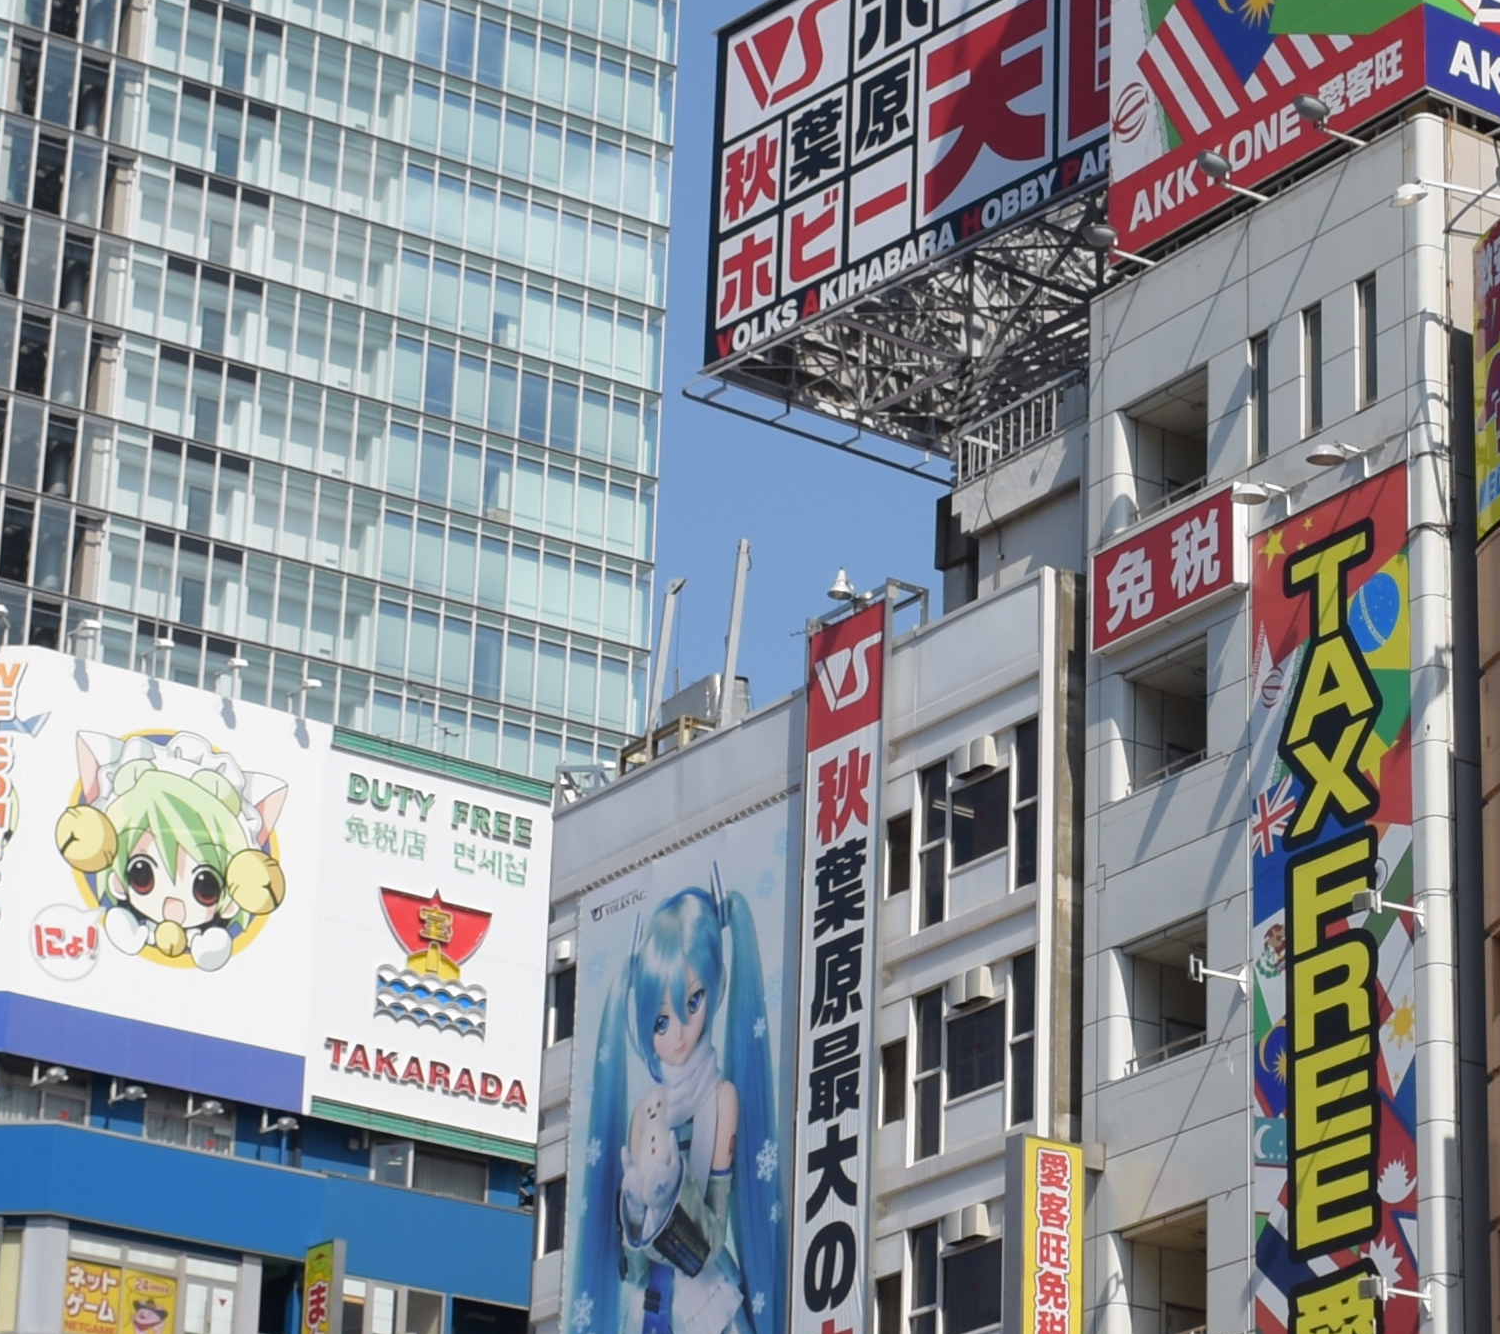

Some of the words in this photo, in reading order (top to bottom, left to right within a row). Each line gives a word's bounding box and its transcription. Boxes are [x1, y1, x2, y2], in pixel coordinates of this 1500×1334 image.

[721, 55, 914, 234] 秋葉原
[715, 295, 799, 359] VOLKS
[800, 223, 956, 319] AKIHABARA
[718, 180, 910, 322] ホビー
[1103, 507, 1221, 634] 免税
[1290, 527, 1370, 841] TAX
[347, 770, 437, 826] DUTY
[450, 798, 535, 851] FREE
[323, 1033, 530, 1112] TAKARADA
[1292, 837, 1377, 1252] FREE
[65, 1292, 116, 1323] ゲーム
[67, 1266, 118, 1294] ネット
